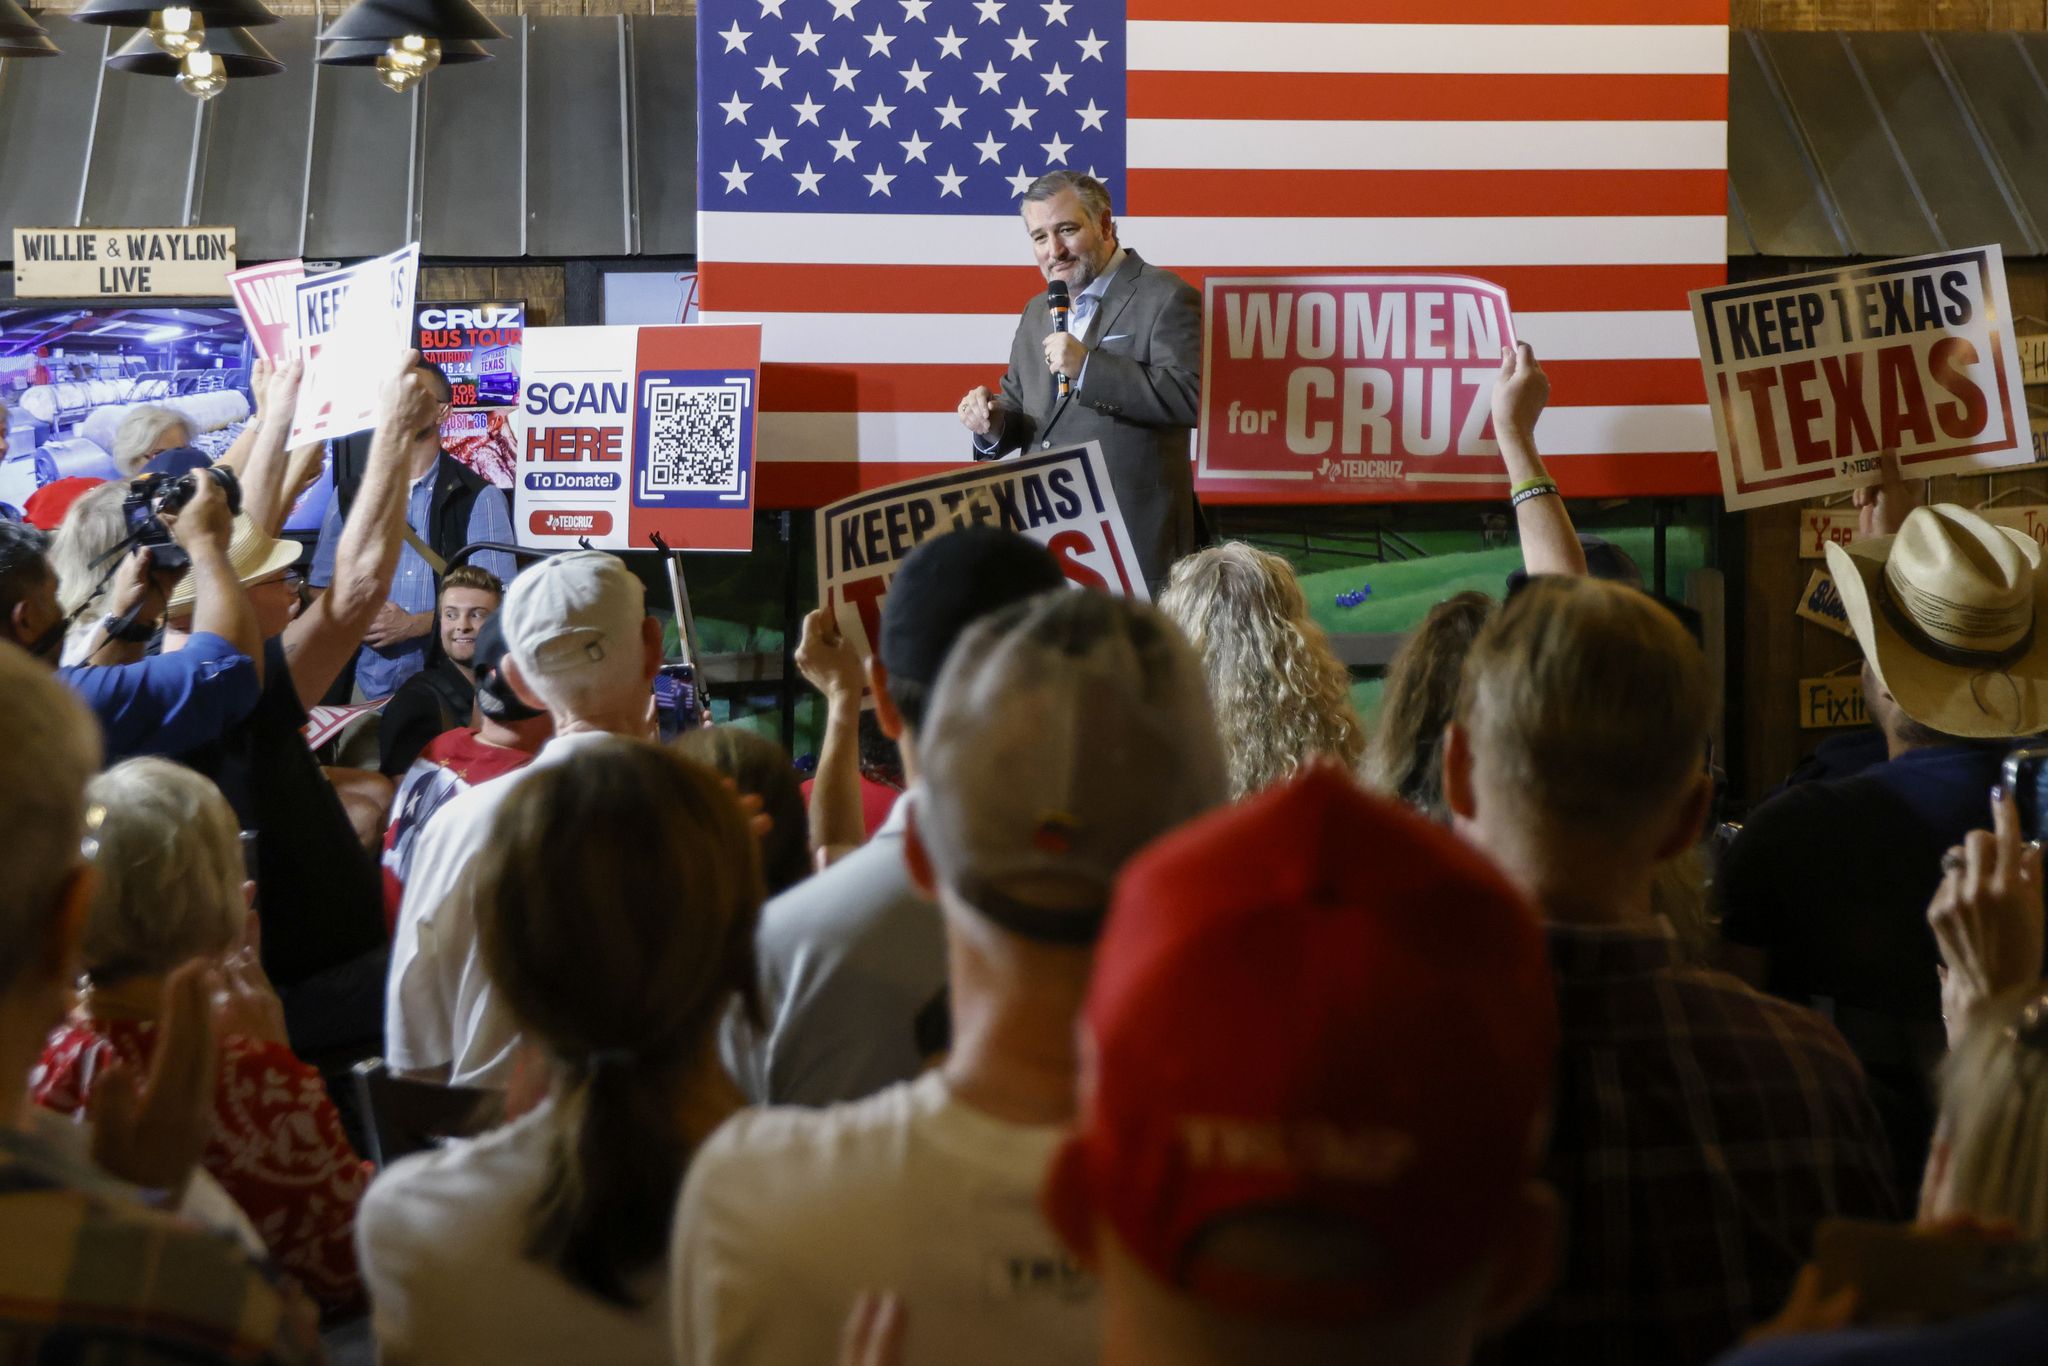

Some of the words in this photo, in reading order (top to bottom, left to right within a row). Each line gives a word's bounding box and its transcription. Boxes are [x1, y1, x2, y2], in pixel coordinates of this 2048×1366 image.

[22, 234, 97, 261] WILLIE
[106, 237, 121, 258] &
[126, 234, 227, 261] WAYLON
[99, 266, 152, 294] LIVE
[419, 308, 520, 329] CRUZ
[1225, 292, 1502, 359] WOMEN
[1725, 293, 1825, 360] KEEP
[1831, 270, 1972, 343] TEXAS
[421, 330, 462, 348] BUS
[467, 328, 522, 347] TOUR
[424, 351, 473, 364] SATURDAY
[440, 362, 472, 374] 05.24
[452, 393, 477, 405] RUZ
[525, 382, 628, 415] SCAN
[1228, 401, 1277, 434] for
[1286, 366, 1502, 456] CRUZ
[1736, 337, 1988, 471] TEXAS
[526, 426, 624, 461] HERE
[533, 473, 551, 487] To
[555, 473, 614, 488] Donate!
